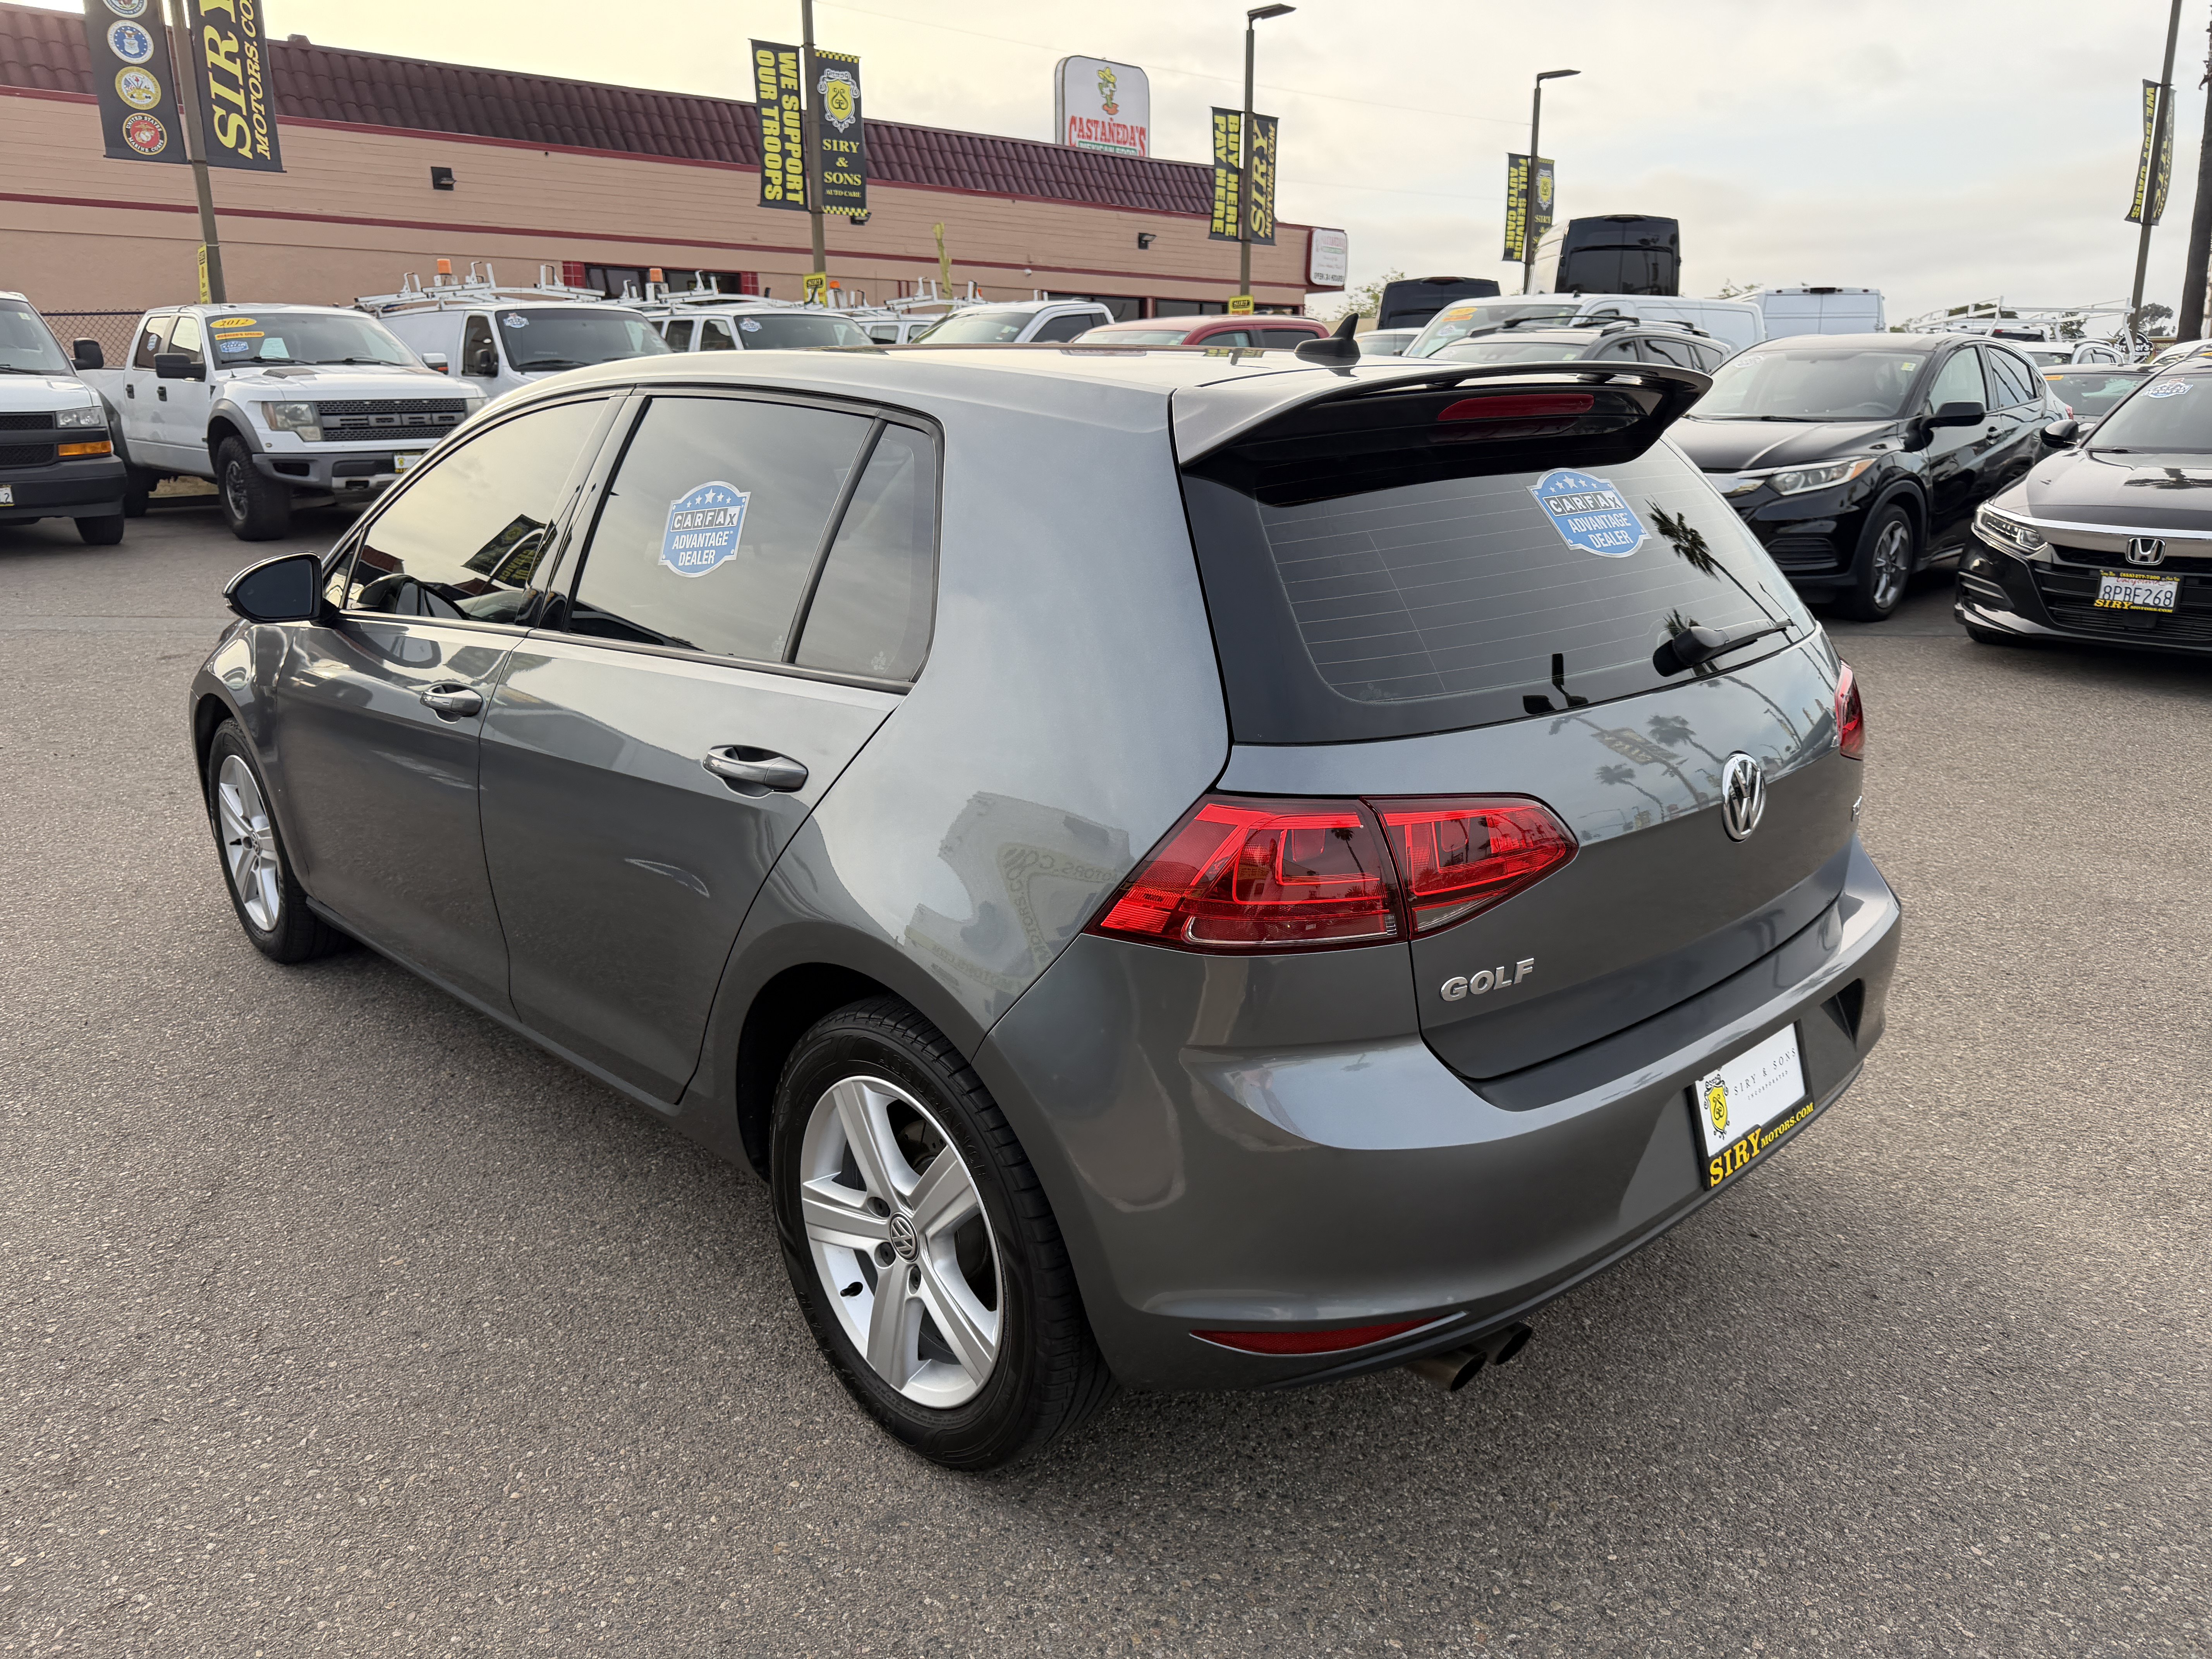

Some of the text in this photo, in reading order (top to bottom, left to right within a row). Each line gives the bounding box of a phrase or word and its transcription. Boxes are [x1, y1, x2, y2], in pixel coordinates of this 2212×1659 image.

[2146, 88, 2155, 117] WE
[126, 116, 162, 132] UNITED STATES
[756, 50, 783, 200] OUR TROOPS
[778, 53, 804, 205] WE SUPPORT
[129, 137, 164, 153] MARINE CORPS
[822, 139, 860, 154] SIRY
[836, 157, 848, 167] &
[824, 172, 862, 186] SONS
[1211, 115, 1227, 233] PAY HERE
[1225, 115, 1239, 237] BUY HERE
[1250, 119, 1267, 238] SIRY
[1265, 122, 1276, 238] MOTORS.COM
[1506, 167, 1518, 249] AUTO CARE
[1513, 198, 1527, 260] SERVICE
[220, 318, 249, 327] 2012
[322, 413, 465, 429] FORD
[1549, 493, 1619, 512] CARFAX
[673, 511, 737, 529] CARFAX
[1567, 512, 1632, 533] ADVANTAGE
[672, 531, 730, 550] ADVANTAGE
[1588, 530, 1634, 548] DEALER
[678, 550, 716, 566] DEALER
[2094, 599, 2133, 610] SIRY
[1440, 958, 1534, 1001] GOLF
[1734, 1048, 1796, 1096] SIRY & SONS
[1710, 1101, 1815, 1187] SIRY MOTORS.COM
